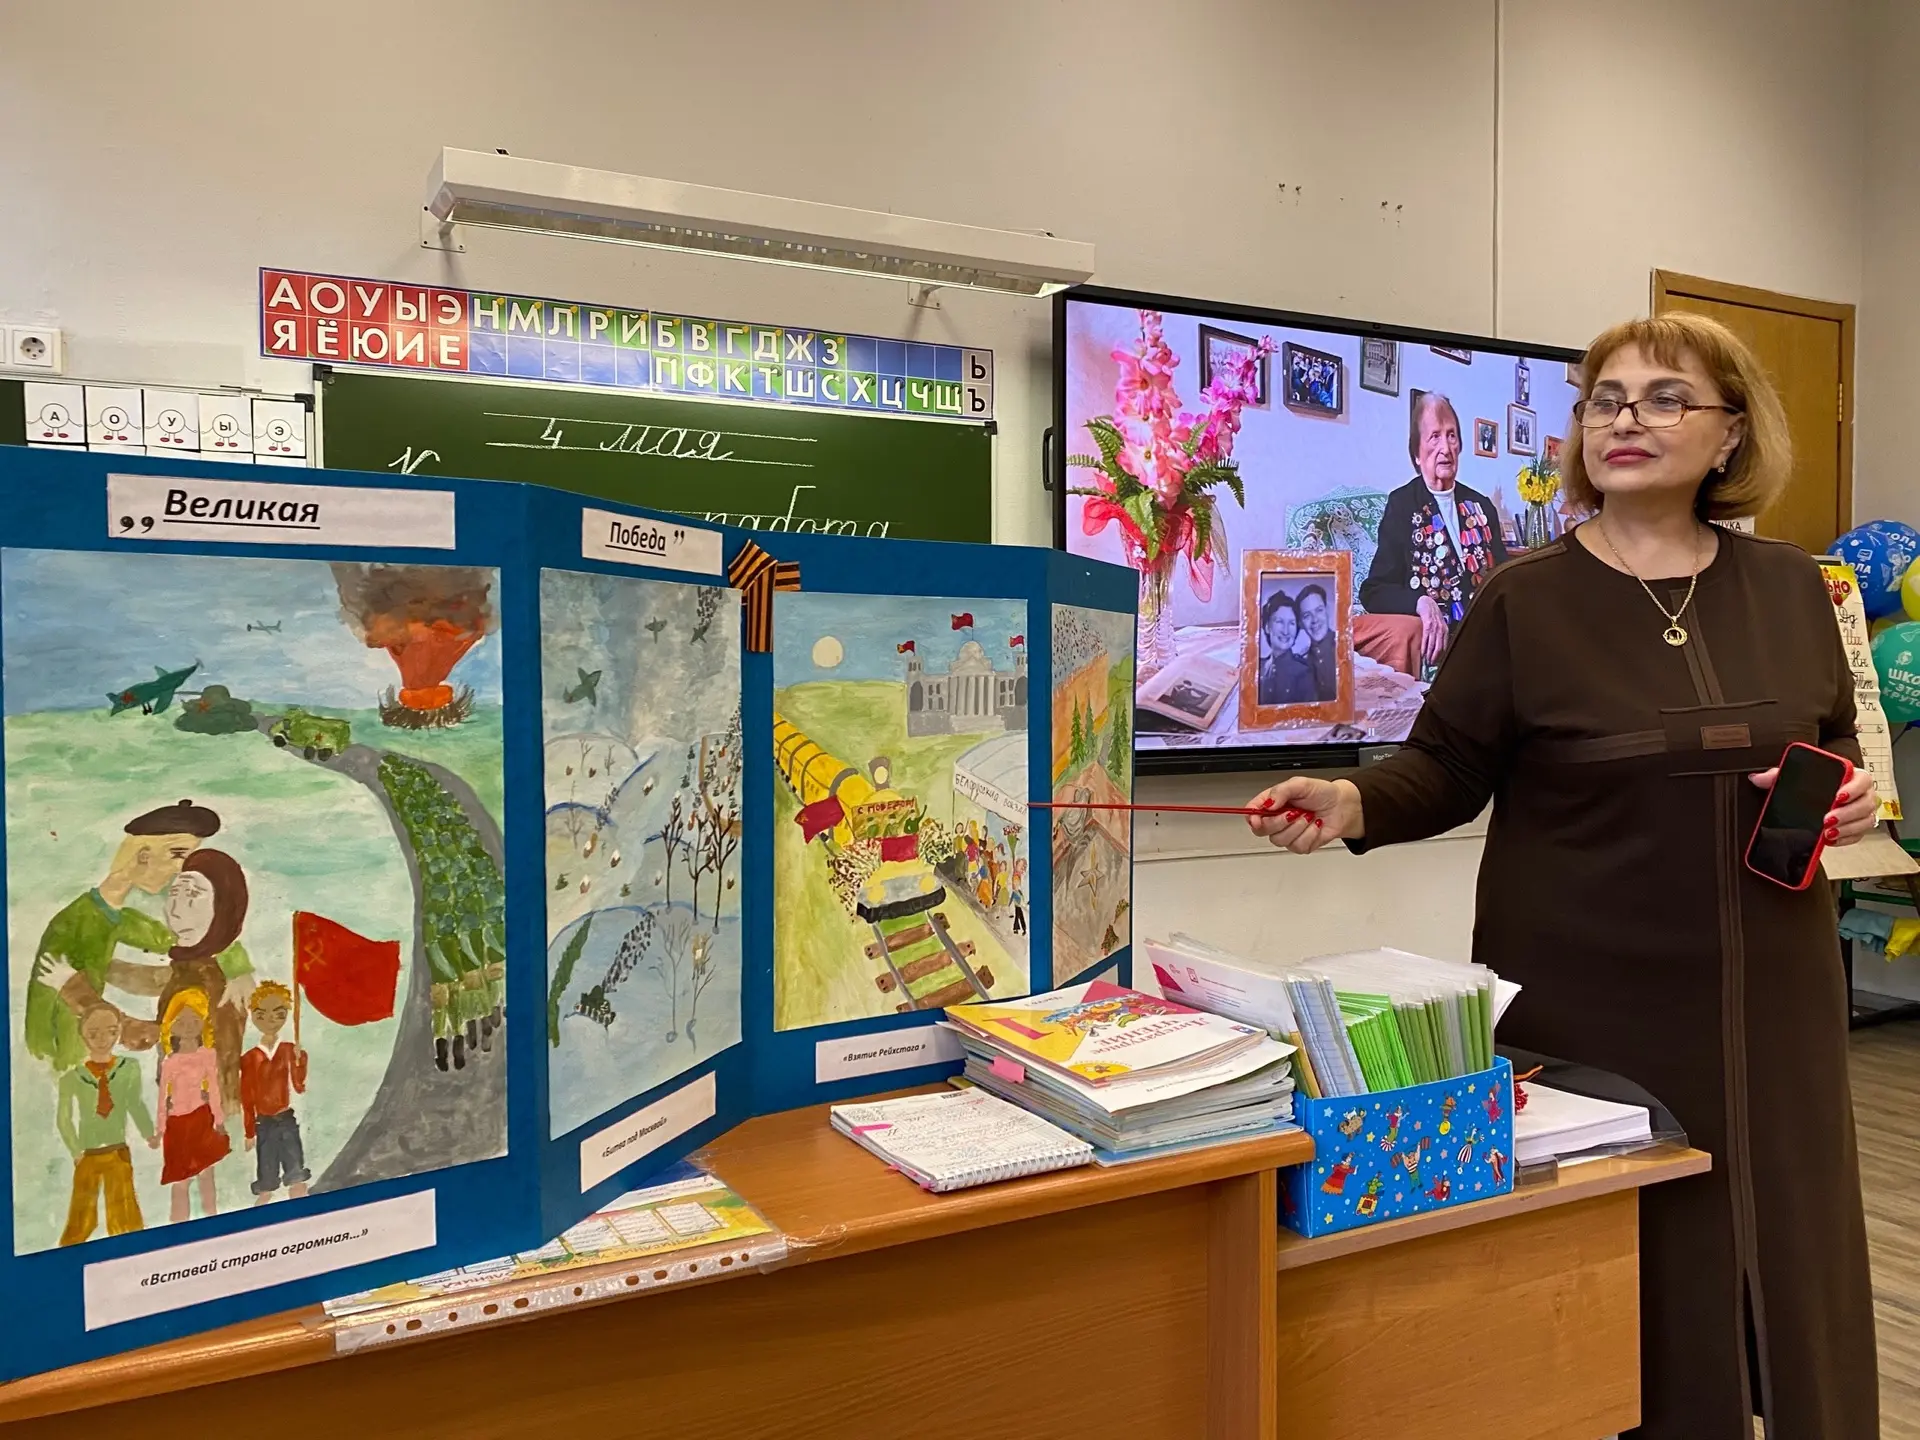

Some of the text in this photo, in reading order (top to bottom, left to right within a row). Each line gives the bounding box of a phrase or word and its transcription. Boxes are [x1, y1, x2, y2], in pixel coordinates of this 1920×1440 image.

[268, 278, 986, 380] А О У Ы Э Н М Л Р Й Б В Г Д Ж З Ь
[272, 319, 985, 415] Я Ё Ю И Е П Ф К Т Ш С Х Ц Ч Щ Ъ
[51, 411, 60, 422] А
[167, 416, 176, 427] У
[219, 421, 232, 432] Ы
[274, 426, 284, 436] Э
[540, 418, 734, 460] 4 мая
[163, 488, 320, 526] Великая
[705, 485, 889, 538] бота
[610, 521, 666, 551] Победа
[1886, 532, 1916, 549] ОЛА
[879, 1044, 919, 1057] Рейхстага
[627, 1131, 638, 1147] под
[140, 1259, 217, 1288] «Вставай
[221, 1247, 277, 1270] страна
